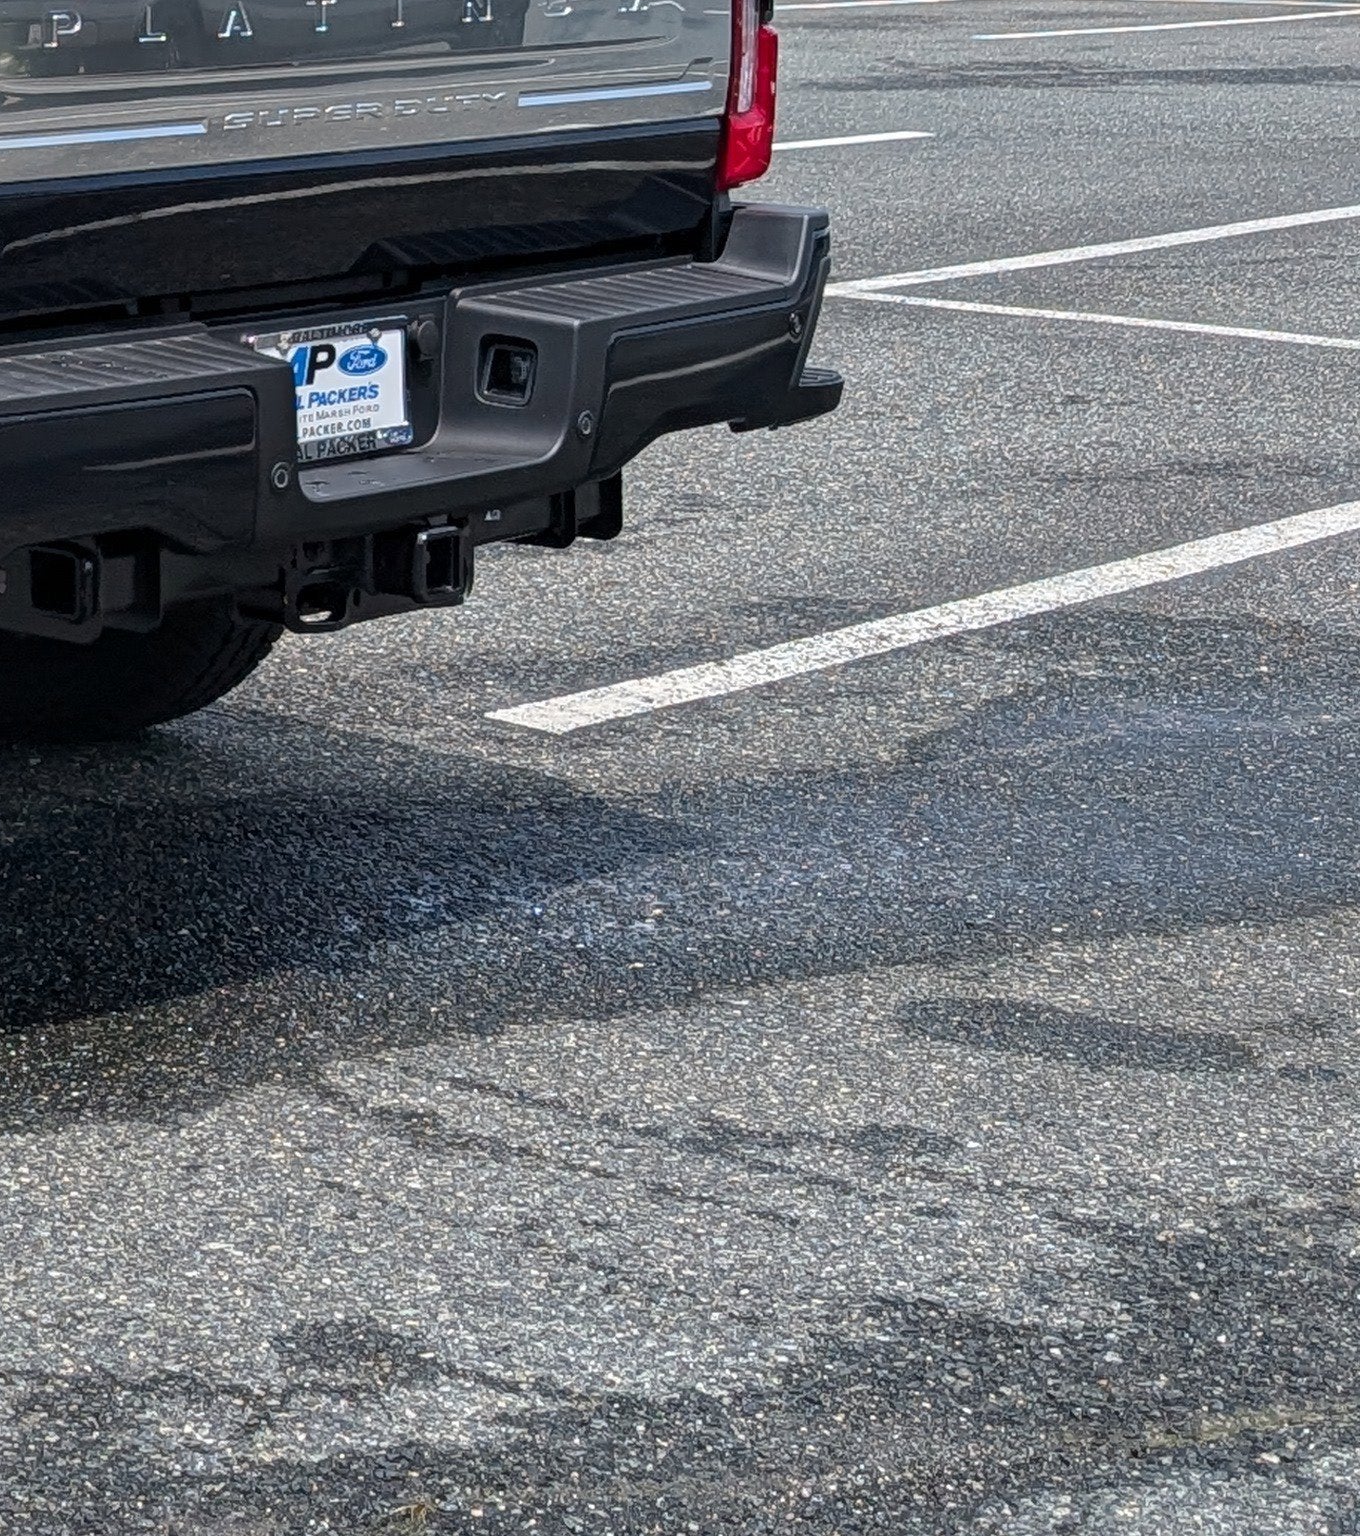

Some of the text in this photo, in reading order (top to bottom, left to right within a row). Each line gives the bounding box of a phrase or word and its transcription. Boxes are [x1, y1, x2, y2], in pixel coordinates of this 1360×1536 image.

[223, 101, 383, 131] SUPER
[308, 381, 380, 410] PACKER'S
[317, 433, 378, 459] PACKER
